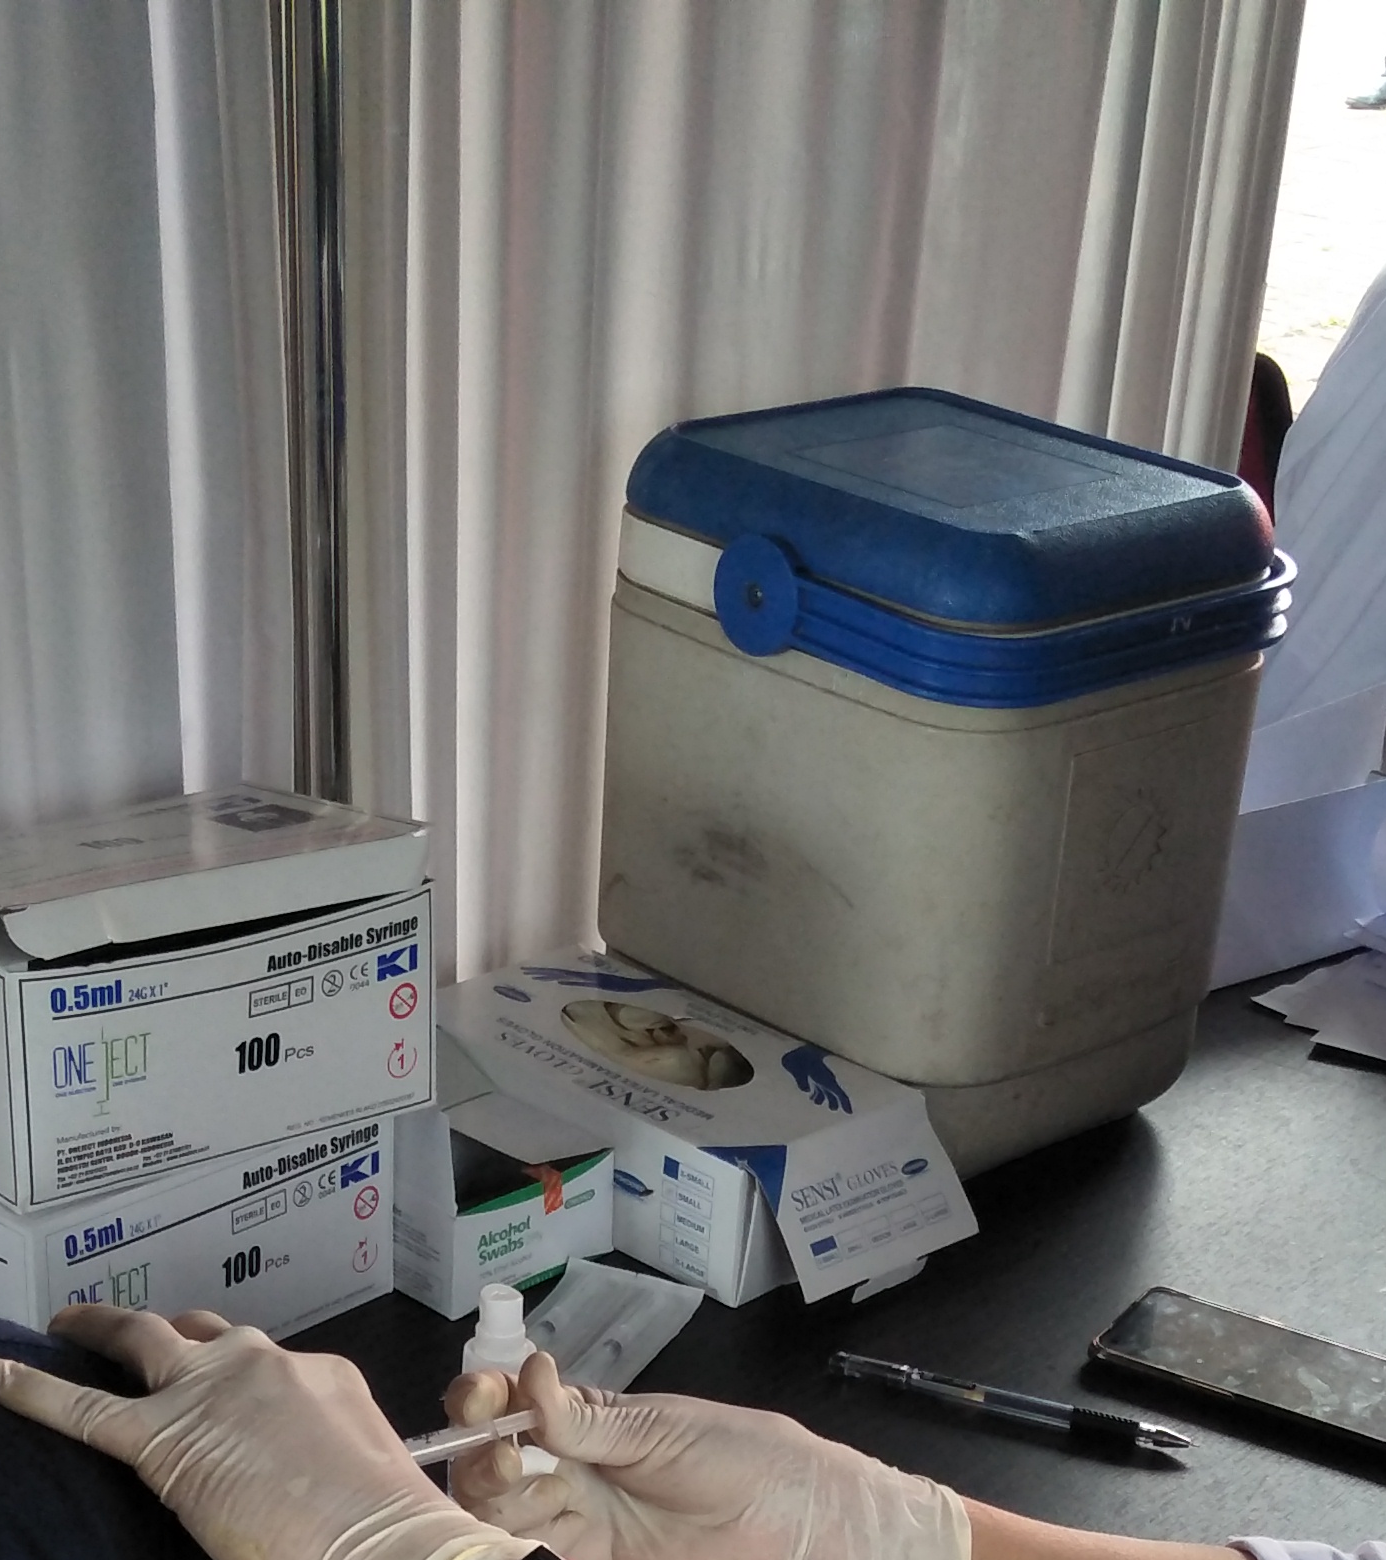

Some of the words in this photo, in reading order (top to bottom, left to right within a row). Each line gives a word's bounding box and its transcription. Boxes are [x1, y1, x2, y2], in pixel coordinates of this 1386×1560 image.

[266, 933, 363, 973] Auto-Disable
[366, 916, 419, 945] Syringe
[50, 979, 123, 1014] 0.5ml
[252, 990, 289, 1008] STERILE
[235, 1032, 280, 1075] 100
[242, 1144, 327, 1190] Auto-Disable
[330, 1123, 379, 1154] Syringe
[847, 1160, 900, 1192] GLOVES
[234, 1207, 265, 1226] STERILE
[677, 1192, 702, 1210] SMALL
[64, 1217, 124, 1260] 0.5ml
[476, 1214, 532, 1251] Alcohol
[676, 1214, 705, 1234] MEDIUM
[478, 1236, 525, 1266] Swabs
[675, 1237, 700, 1255] LARGE
[222, 1245, 262, 1289] 100
